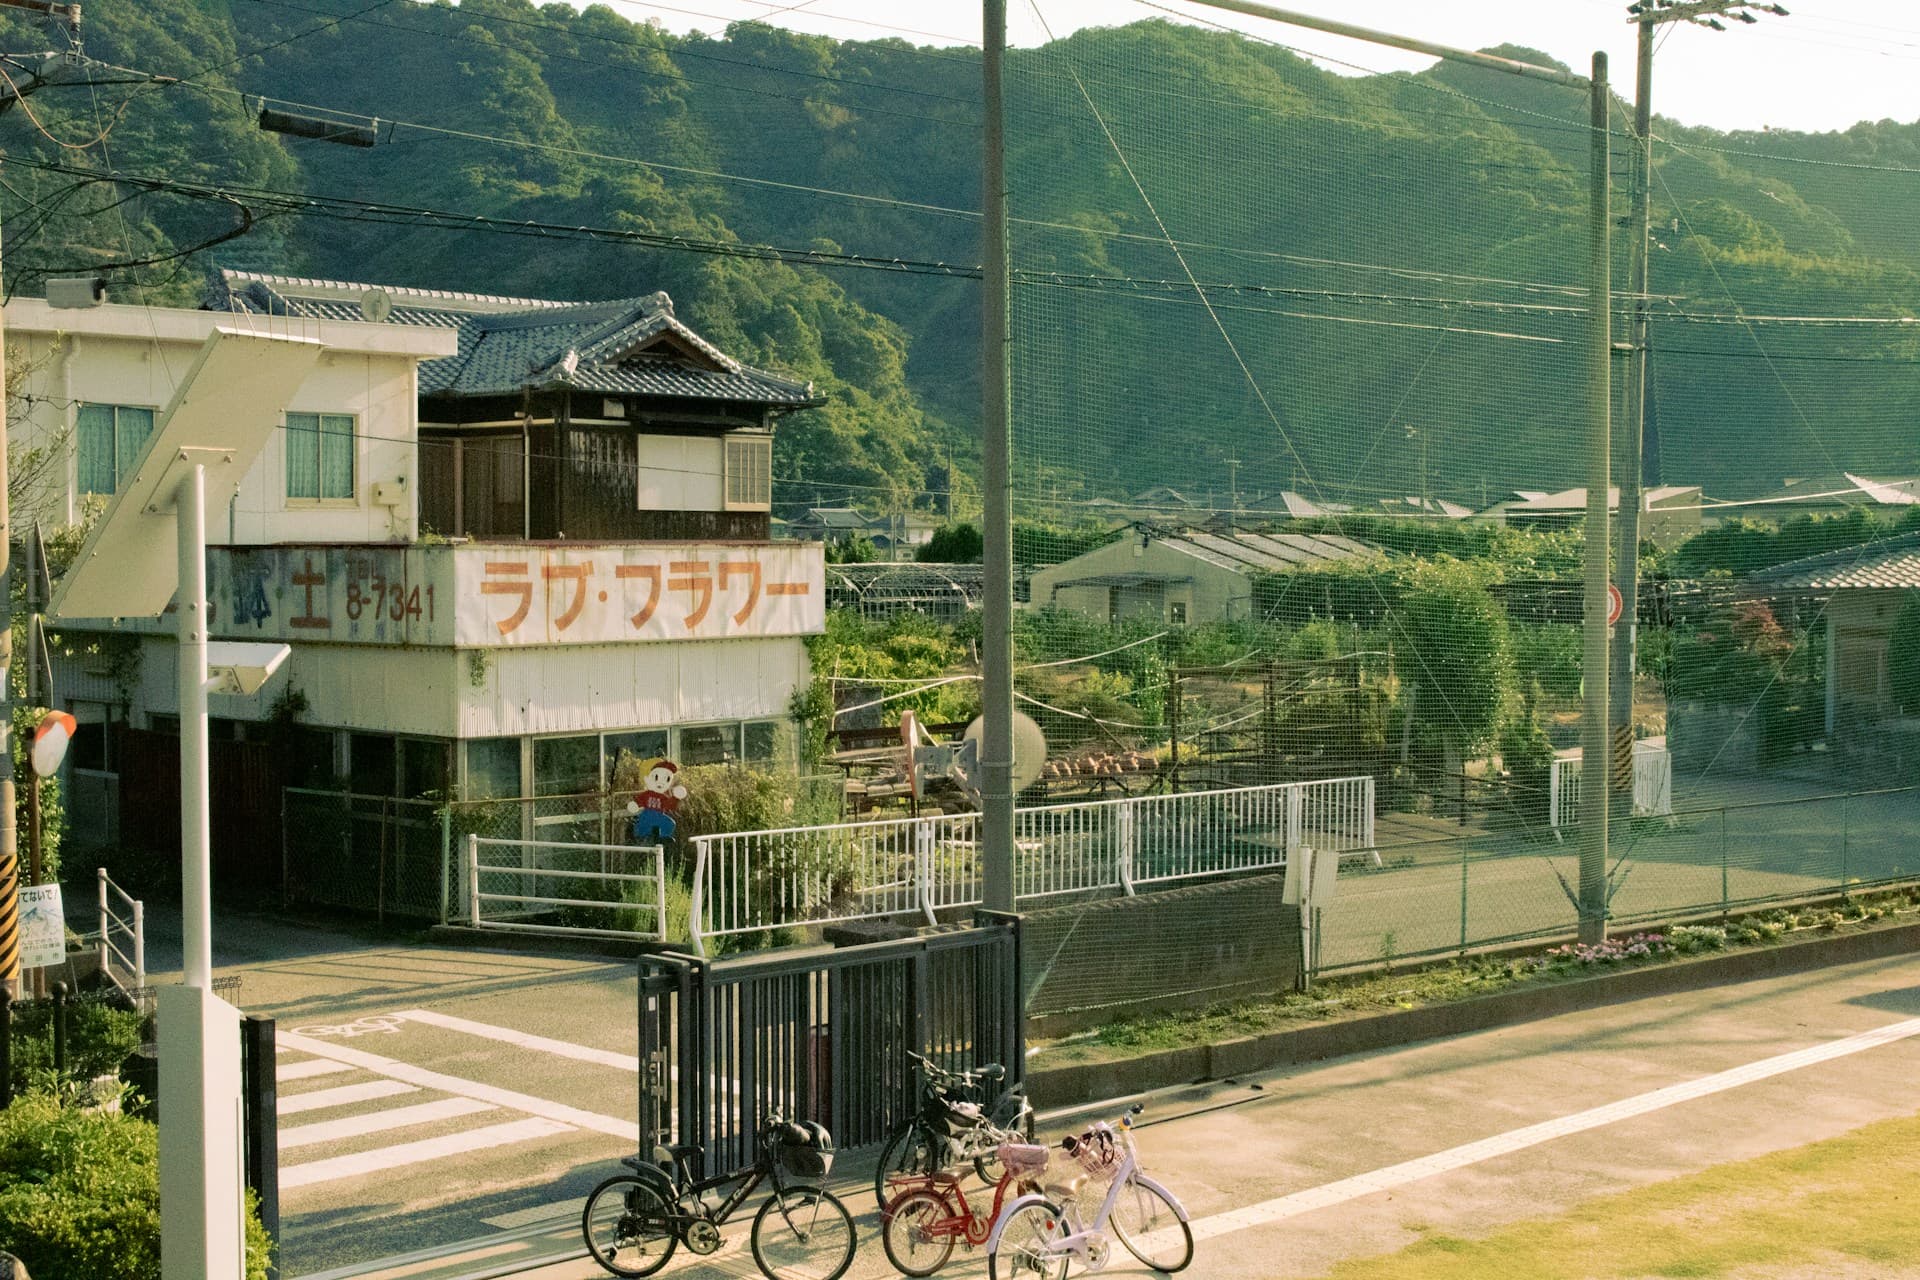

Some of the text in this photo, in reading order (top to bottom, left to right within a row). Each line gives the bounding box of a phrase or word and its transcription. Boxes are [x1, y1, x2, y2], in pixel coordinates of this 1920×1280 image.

[347, 582, 435, 623] 8-7341
[480, 560, 809, 636] ラブ・フラワー
[18, 888, 58, 903] てないで!
